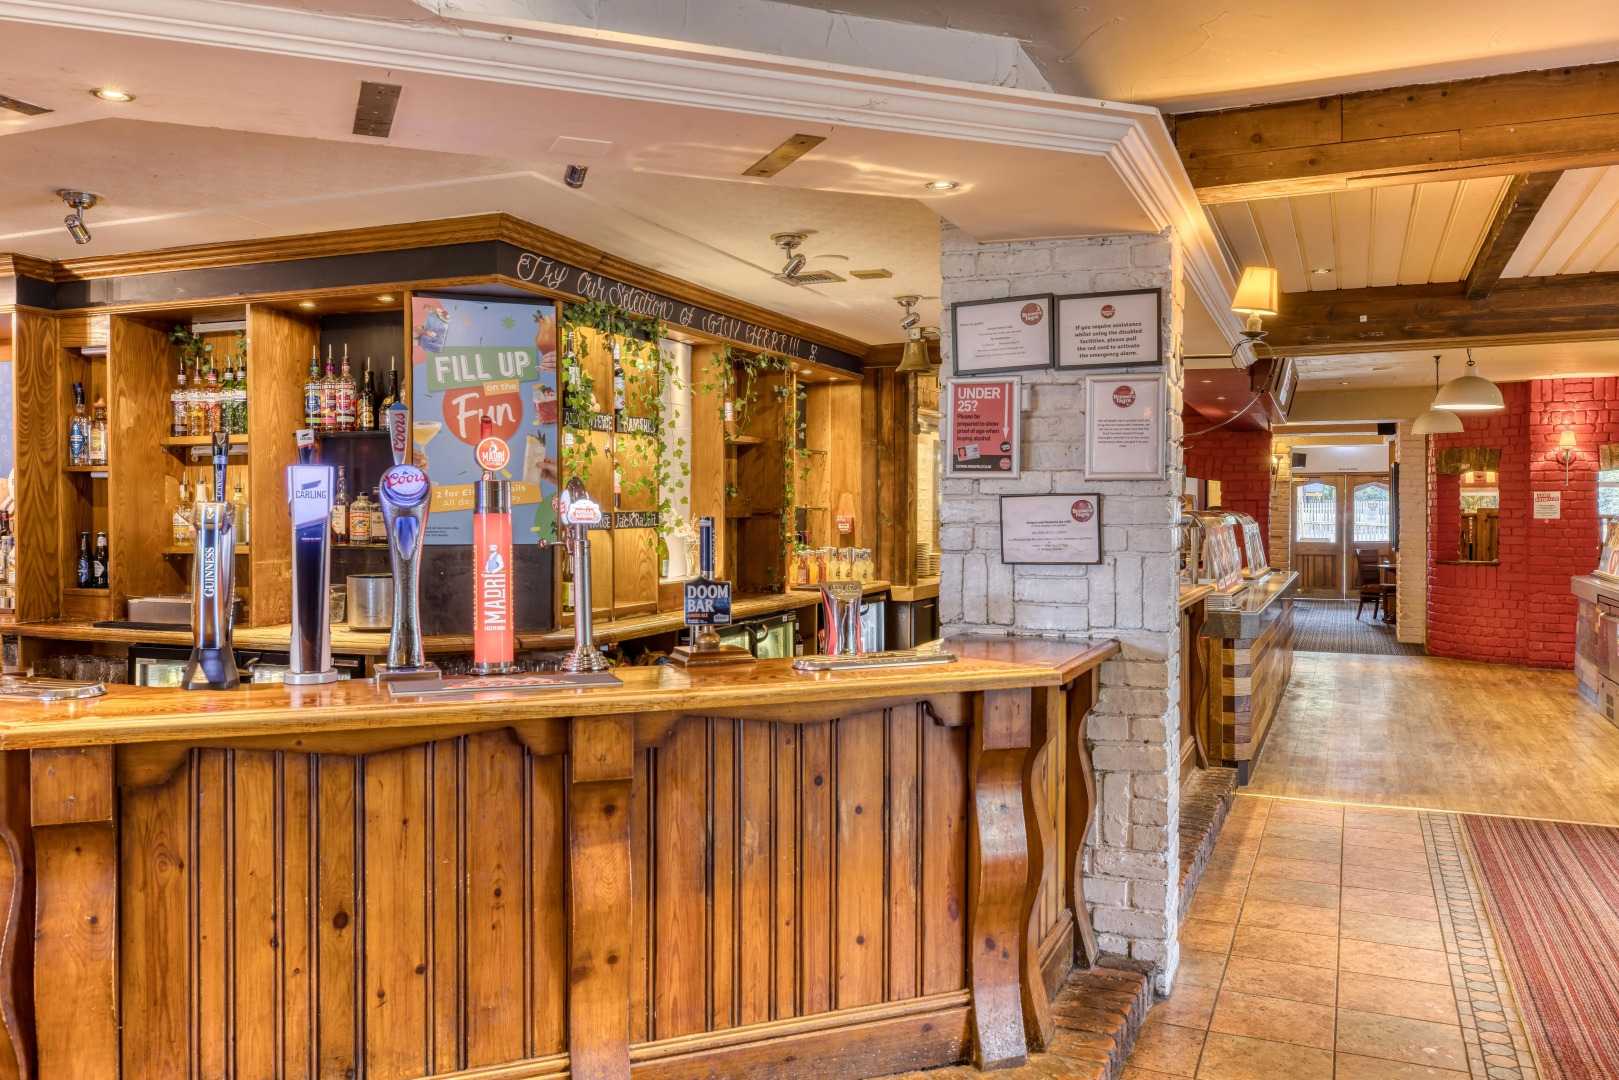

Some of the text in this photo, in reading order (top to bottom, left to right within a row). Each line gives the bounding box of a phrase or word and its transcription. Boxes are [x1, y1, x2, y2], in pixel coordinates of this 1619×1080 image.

[517, 252, 569, 289] Try
[577, 272, 608, 300] Our
[609, 283, 673, 320] Selection
[434, 351, 530, 383] FILL UP
[500, 382, 517, 390] the
[958, 387, 1000, 399] UNDER
[958, 400, 978, 412] 25?
[452, 392, 516, 438] Fun
[392, 413, 406, 452] Coors
[386, 472, 427, 488] Coors
[296, 491, 326, 499] CARLING
[445, 490, 459, 498] for
[615, 513, 634, 528] Jack
[204, 547, 215, 597] GUINNESS
[481, 573, 506, 624] MADRÍ
[687, 585, 729, 599] DOOM
[688, 599, 715, 612] BAR
